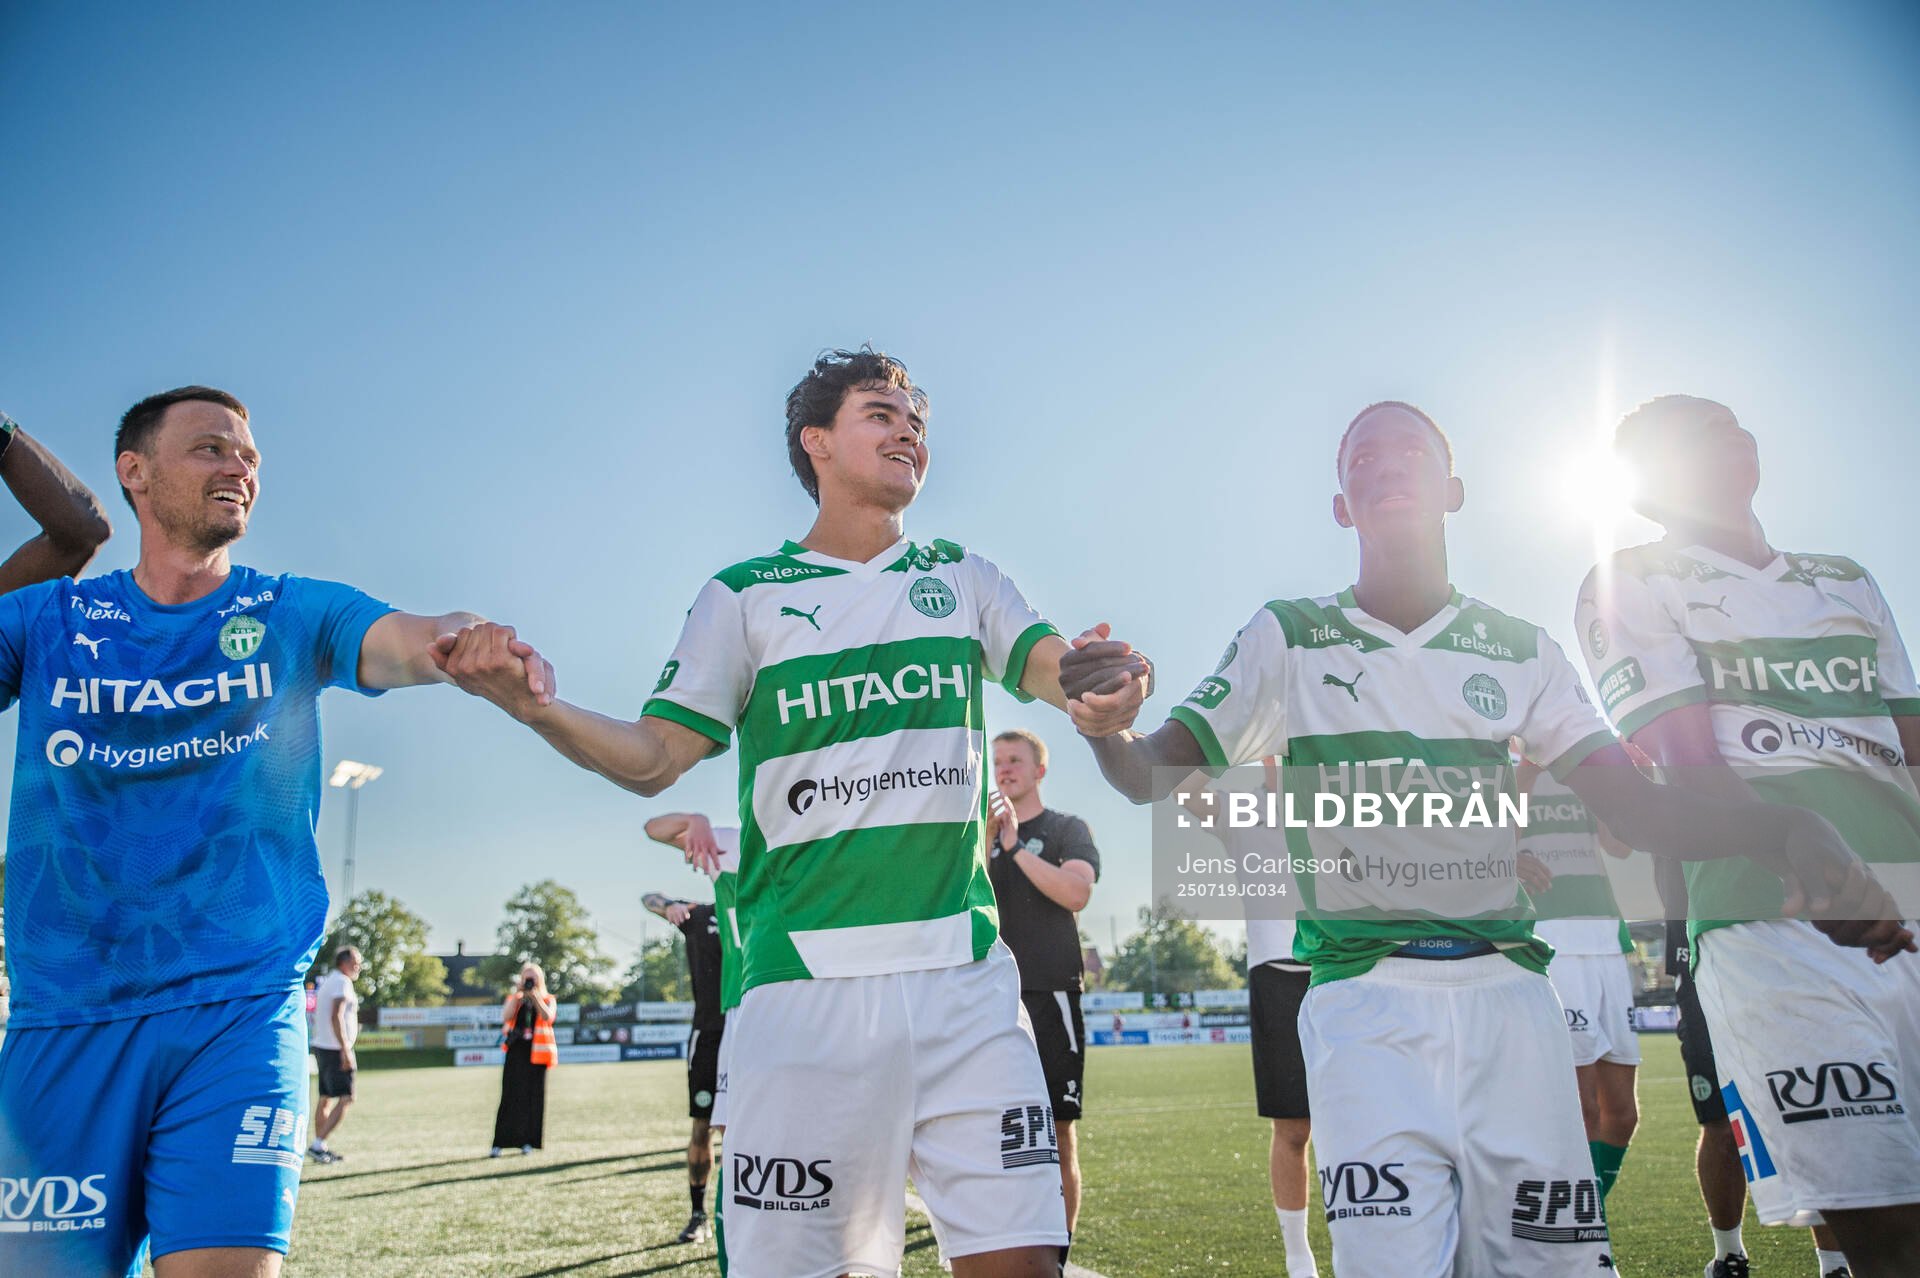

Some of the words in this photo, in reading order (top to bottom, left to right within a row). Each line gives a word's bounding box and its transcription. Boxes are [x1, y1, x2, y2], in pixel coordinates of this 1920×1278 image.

[750, 567, 823, 580] Telexia
[1449, 632, 1514, 658] Telexia
[49, 662, 273, 714] HITACHI
[1419, 940, 1453, 949] BORG
[1765, 1062, 1897, 1112] RYDS
[1831, 1104, 1905, 1118] BILGLAS
[734, 1153, 833, 1198] RYDS
[764, 1199, 830, 1211] BILGLAS
[1338, 1206, 1412, 1219] BILGLAS
[32, 1217, 106, 1232] BILGLAS
